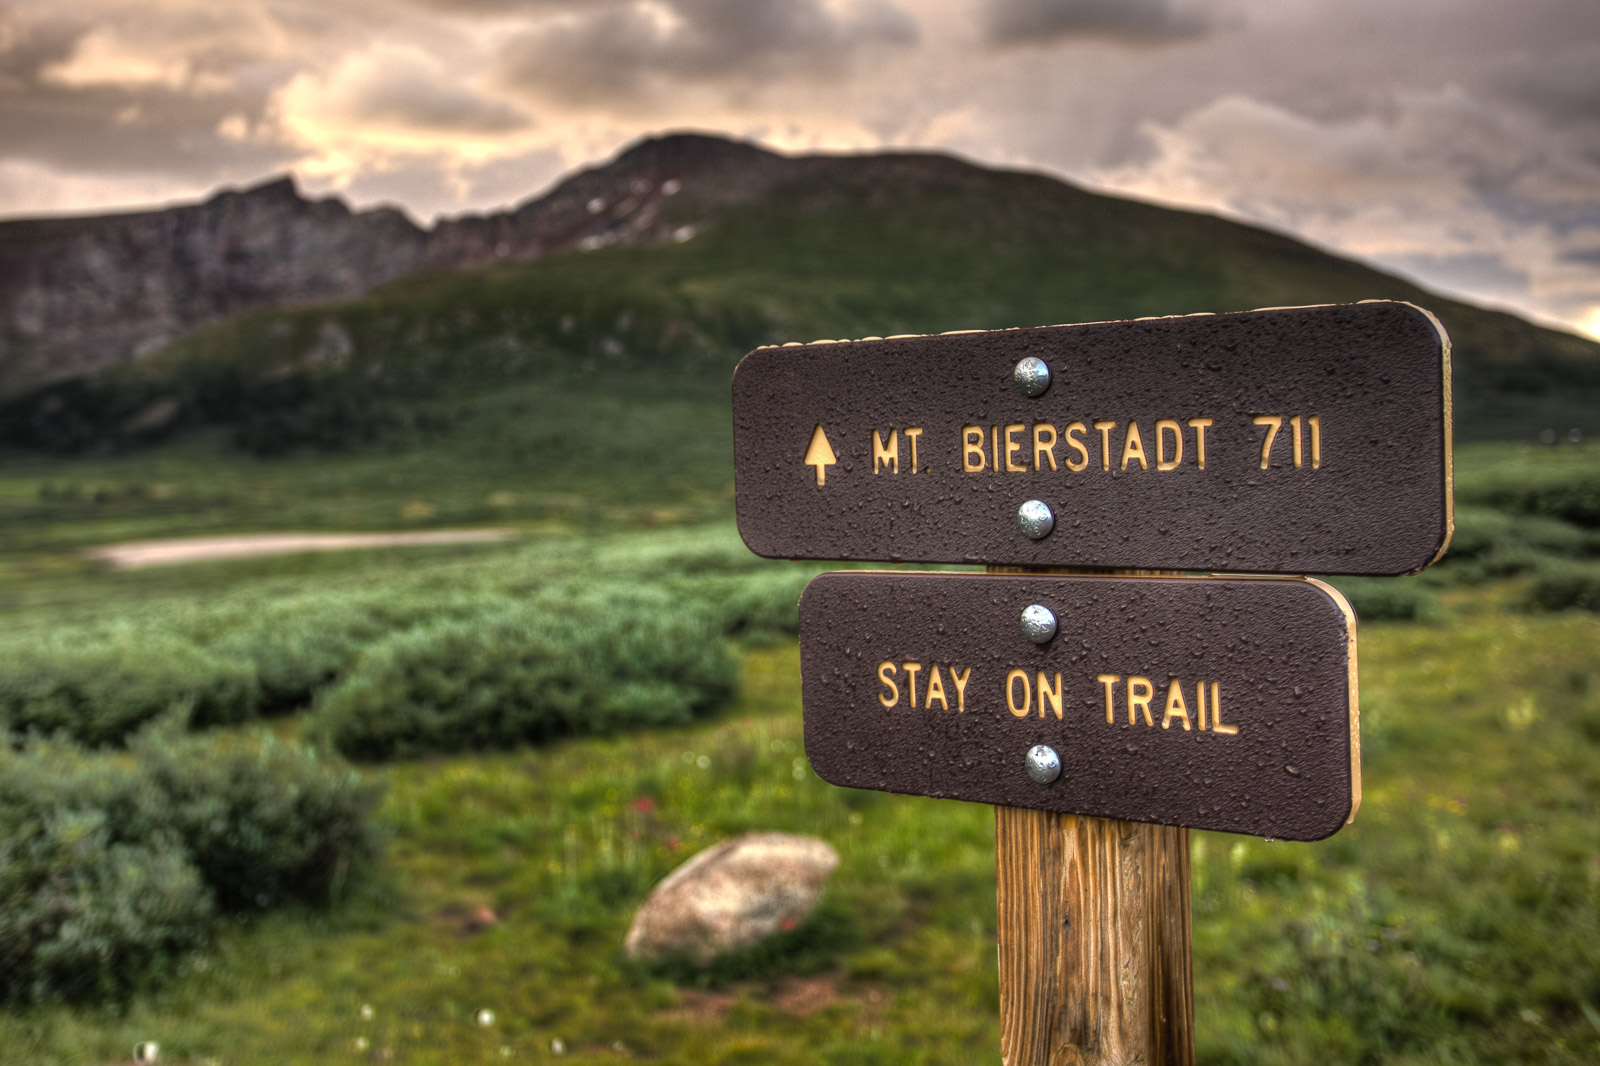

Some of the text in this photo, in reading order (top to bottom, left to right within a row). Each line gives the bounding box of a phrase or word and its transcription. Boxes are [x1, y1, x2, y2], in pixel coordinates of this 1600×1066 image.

[961, 417, 1214, 475] BIERSTADT
[1252, 414, 1322, 471] 711
[876, 660, 1240, 737] STAY ON TRAIL
